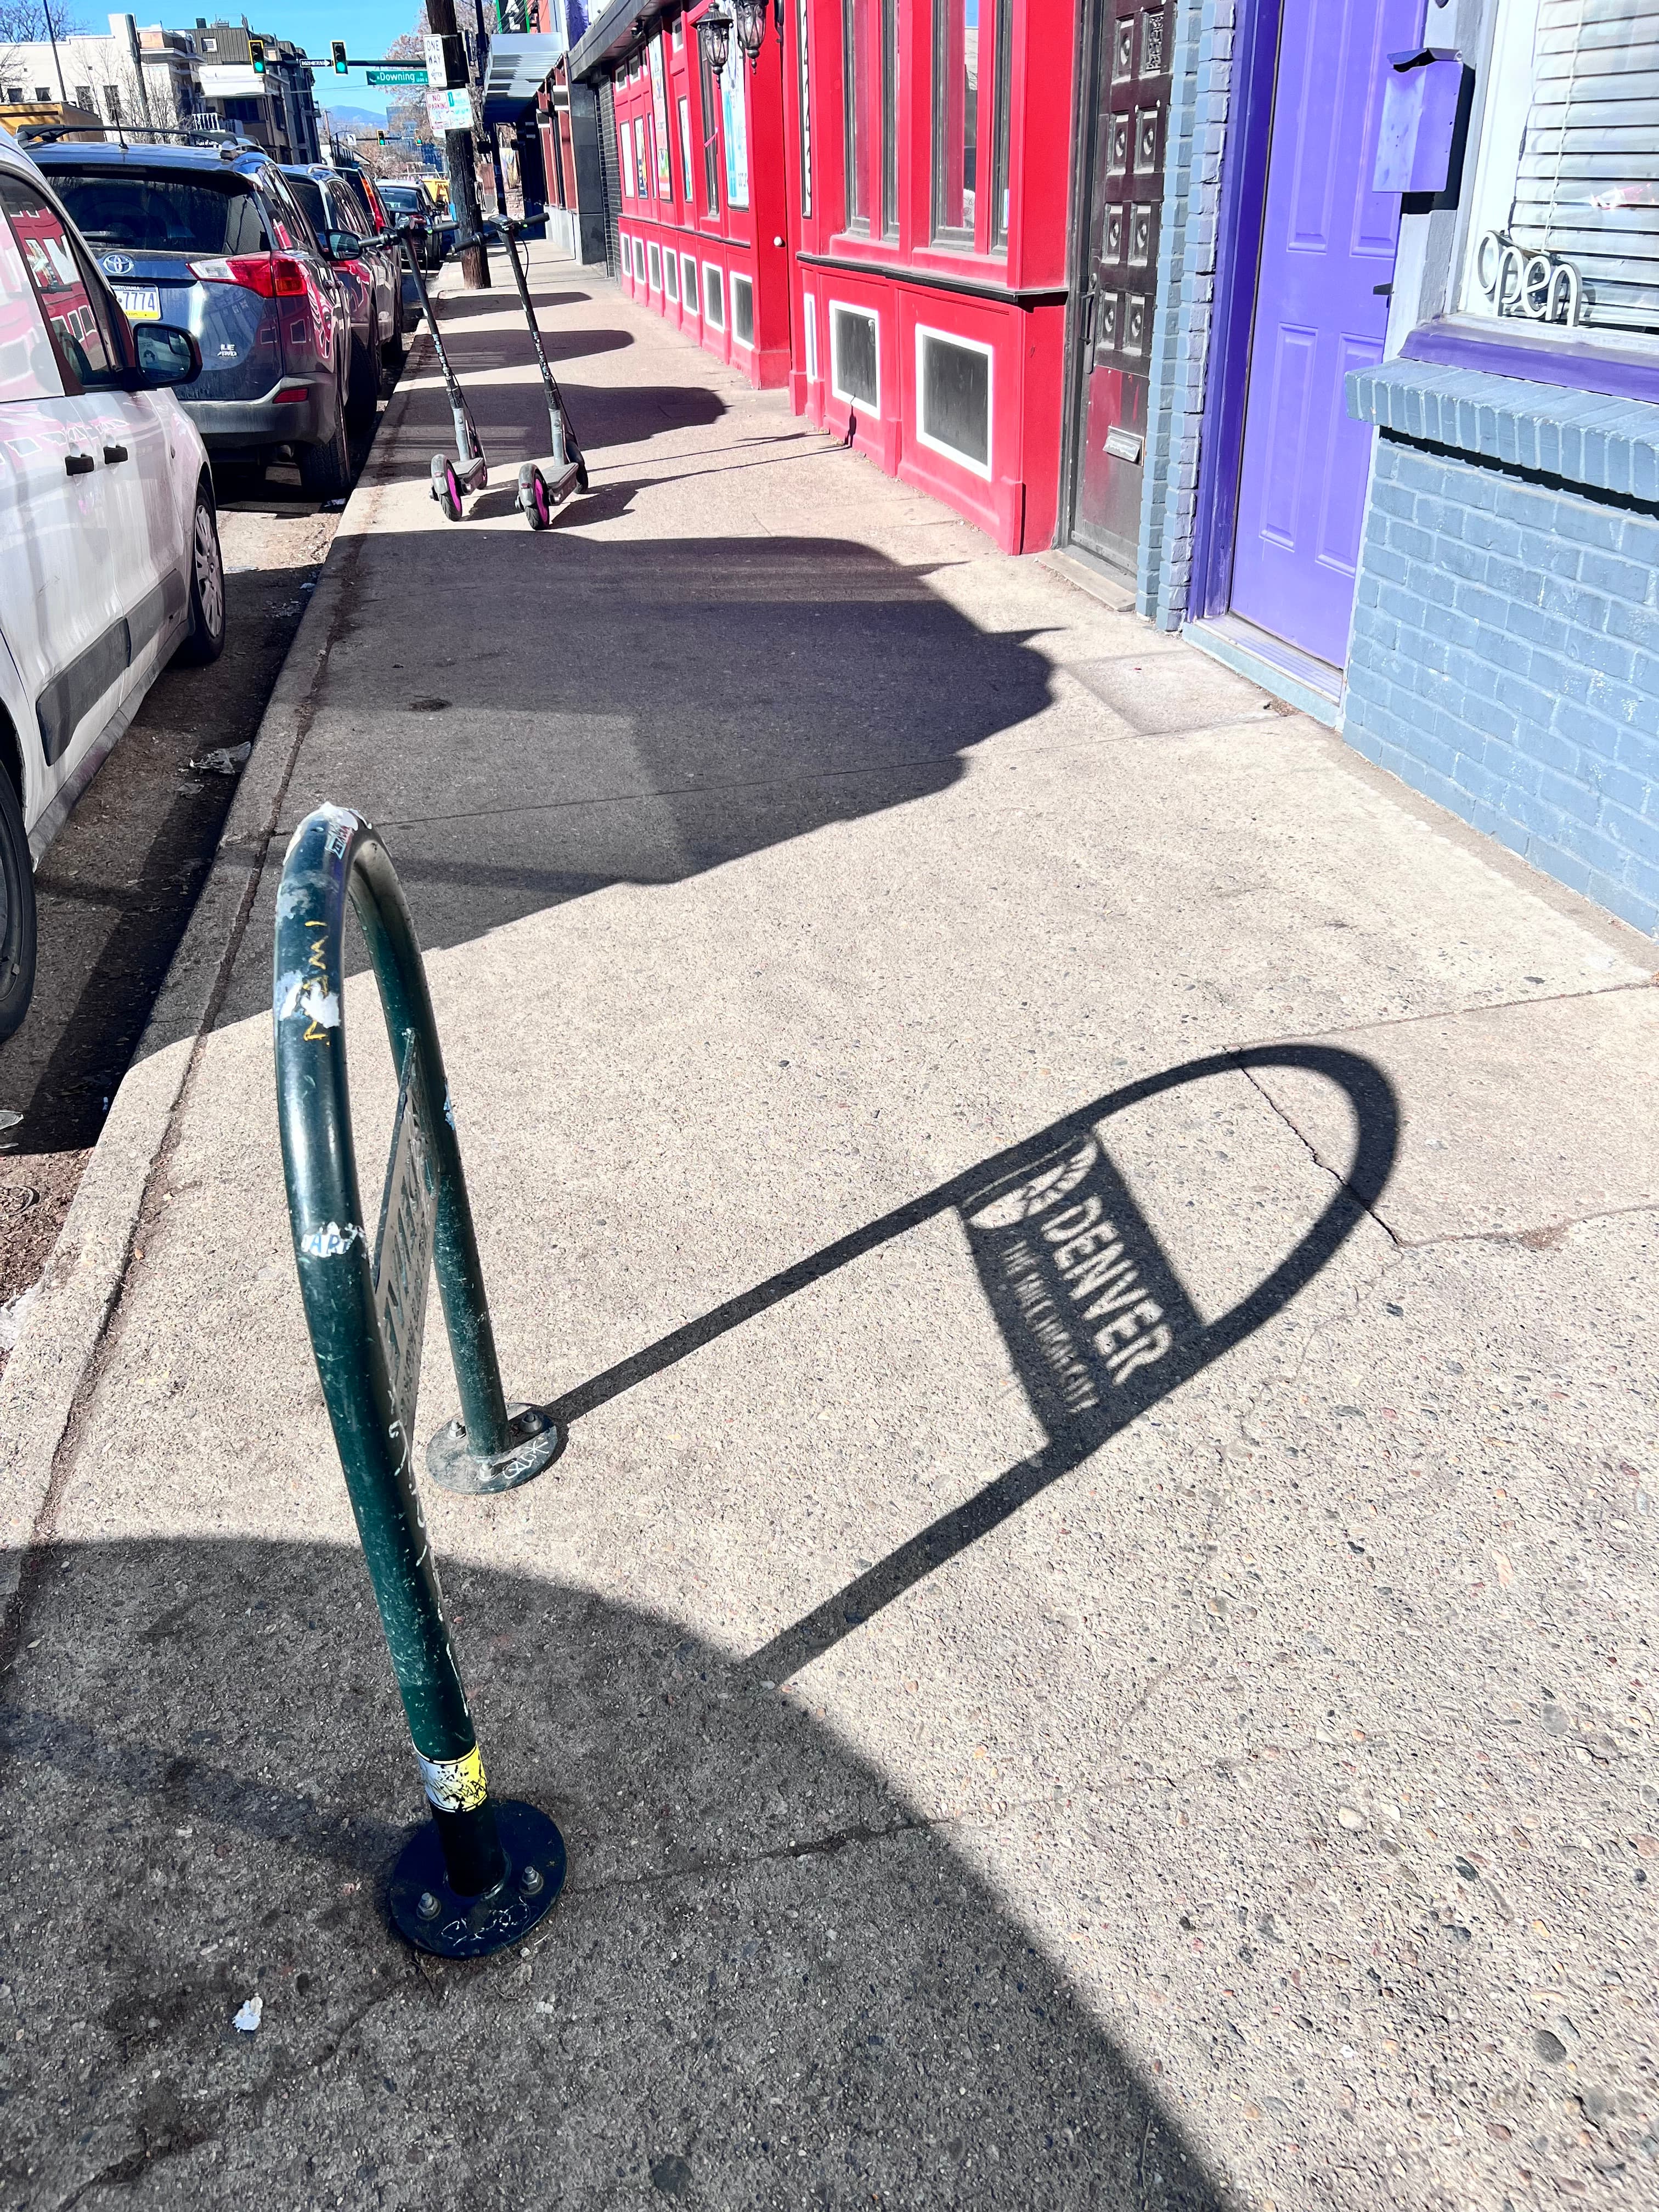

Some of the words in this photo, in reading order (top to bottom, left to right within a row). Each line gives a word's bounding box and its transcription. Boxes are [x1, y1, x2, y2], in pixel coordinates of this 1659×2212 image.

[426, 40, 440, 52] ONE
[428, 54, 441, 65] WAY
[380, 71, 415, 83] Downing
[1040, 1194, 1173, 1387] DENVER
